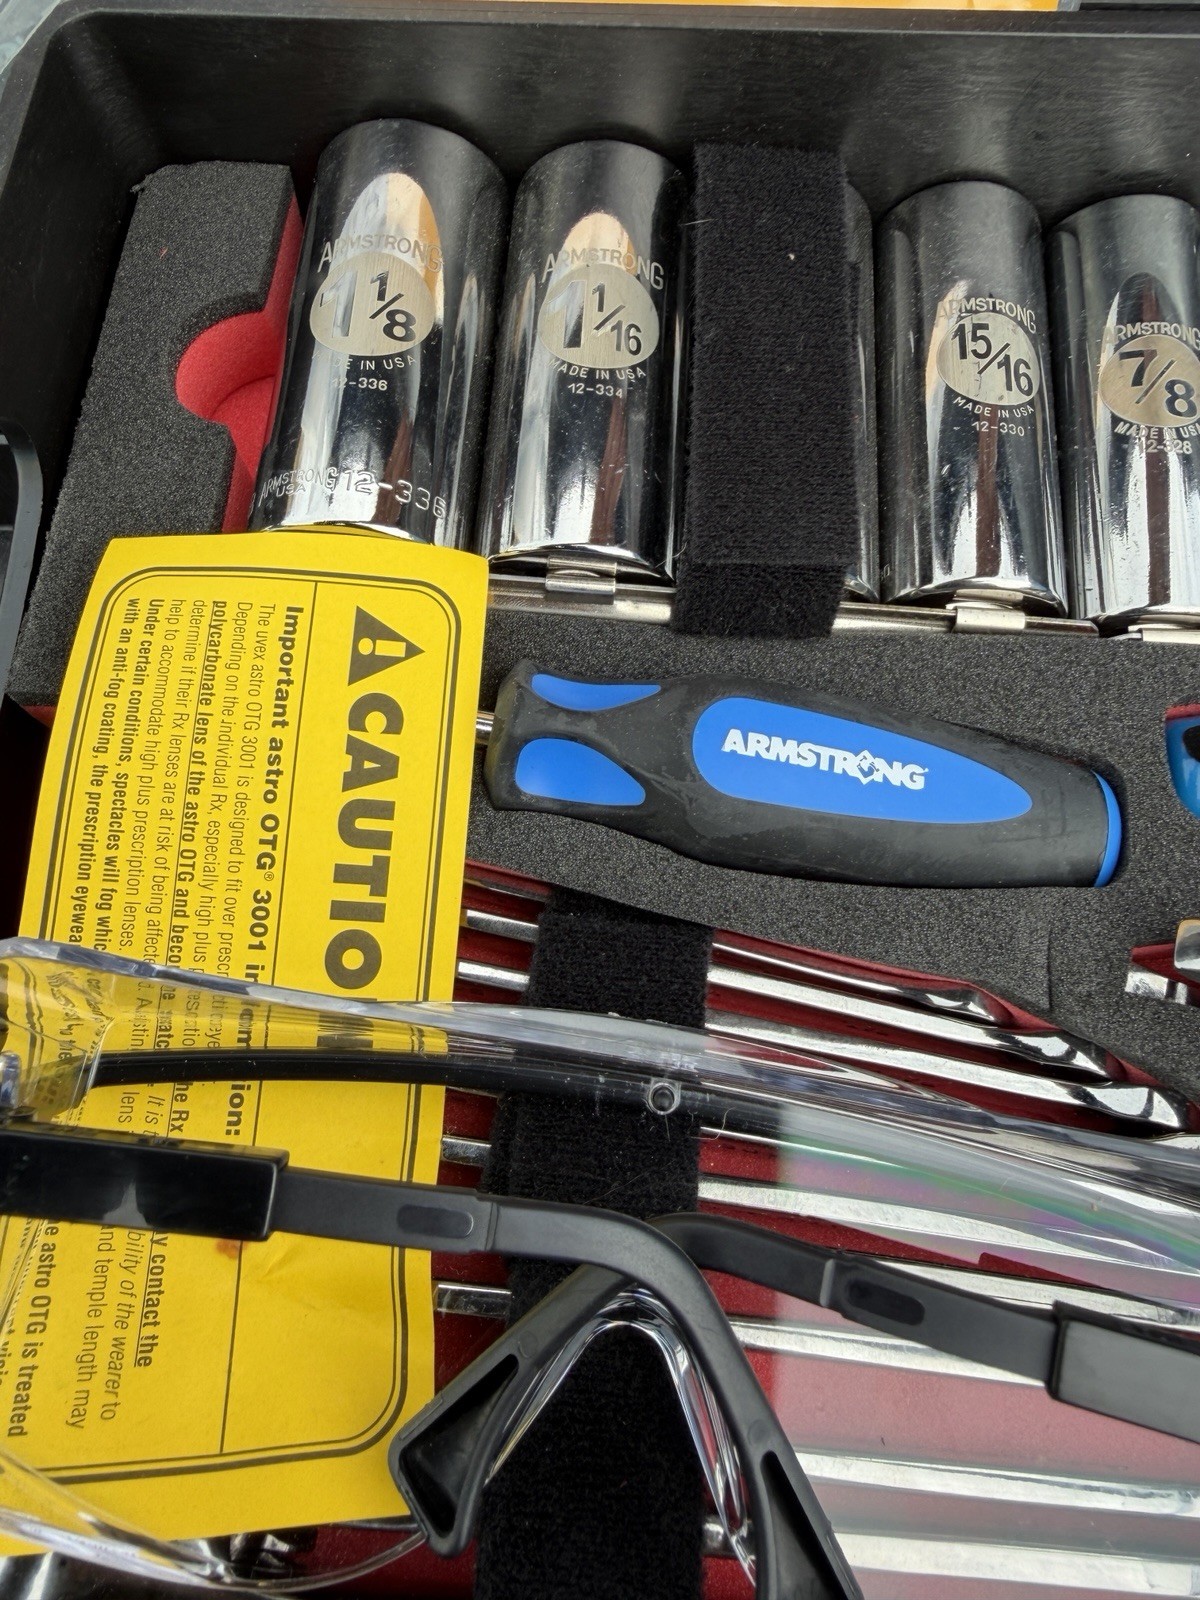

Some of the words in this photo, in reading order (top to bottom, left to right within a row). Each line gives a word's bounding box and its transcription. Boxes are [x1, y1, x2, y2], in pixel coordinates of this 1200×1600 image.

[317, 234, 442, 273] ARMSTRONG
[541, 245, 664, 290] ARMSTRONG
[360, 360, 376, 371] IN
[383, 354, 416, 370] USA
[548, 360, 589, 379] MADE
[595, 367, 610, 380] IN
[615, 367, 647, 381] USA
[951, 322, 1033, 396] 15/16
[567, 383, 624, 398] 12-334
[1118, 348, 1198, 418] 7/8
[953, 396, 992, 417] MADE
[998, 409, 1009, 419] IN
[1014, 404, 1035, 418] USA
[971, 421, 1025, 437] 12-330
[1114, 421, 1159, 439] MADE
[1163, 426, 1178, 440] IN
[276, 483, 306, 498] USA
[346, 469, 447, 519] 12-336
[123, 599, 140, 623] with
[143, 599, 165, 636] Under
[165, 599, 186, 624] help
[258, 604, 275, 626] The
[119, 629, 132, 643] an
[164, 629, 179, 640] to
[183, 600, 207, 661] determine
[225, 602, 253, 670] Depending
[253, 631, 270, 660] uvex
[133, 640, 153, 685] certain
[200, 601, 227, 706] polycarbonate
[272, 606, 304, 728] Important
[104, 648, 129, 698] anti-fog
[182, 666, 197, 674] if
[225, 675, 239, 691] on
[248, 665, 264, 696] astro
[147, 645, 174, 735] accommodate
[175, 679, 194, 708] their
[172, 712, 189, 729] Rx
[222, 697, 239, 716] the
[244, 702, 262, 730] OTG
[93, 703, 117, 759] coating,
[116, 690, 142, 767] conditions,
[194, 712, 213, 744] lens
[140, 740, 161, 770] high
[166, 735, 186, 777] lenses
[192, 751, 207, 766] of
[212, 720, 236, 788] individual
[240, 736, 258, 769] 3001
[721, 728, 929, 790] ARMSTRONG
[91, 765, 108, 786] the
[188, 771, 205, 796] the
[237, 776, 253, 787] is
[264, 737, 284, 804] astro
[137, 775, 155, 805] plus
[163, 782, 177, 803] are
[208, 794, 227, 814] Rx,
[106, 773, 129, 850] spectacles
[159, 809, 175, 821] at
[182, 802, 199, 842] astro
[229, 792, 251, 855] designed
[77, 792, 102, 880] prescription
[156, 826, 174, 851] risk
[126, 811, 148, 896] prescription
[154, 857, 169, 870] of
[178, 849, 197, 882] OTG
[198, 821, 221, 890] especially
[228, 861, 244, 873] to
[102, 856, 121, 882] will
[95, 888, 118, 910] fog
[146, 876, 169, 914] being
[225, 879, 242, 892] fit
[69, 886, 88, 942] eyewea
[174, 888, 189, 917] and
[195, 896, 216, 926] high
[222, 897, 237, 927] over
[94, 916, 112, 950] whic
[119, 902, 141, 951] lenses.
[248, 890, 272, 950] 3001
[193, 932, 211, 962] plus
[118, 1091, 139, 1123] lens
[148, 1096, 165, 1107] It
[145, 1111, 163, 1124] is
[170, 1110, 190, 1133] Rx
[35, 1243, 57, 1288] astro
[86, 1259, 111, 1318] temple
[120, 1280, 137, 1298] of
[142, 1254, 166, 1327] contact
[27, 1295, 51, 1334] OTG
[114, 1303, 134, 1329] the
[23, 1342, 42, 1358] is
[76, 1325, 104, 1382] length
[137, 1335, 158, 1367] the
[104, 1336, 127, 1398] wearer
[8, 1365, 38, 1437] treated
[66, 1390, 89, 1429] may
[100, 1401, 121, 1420] to
